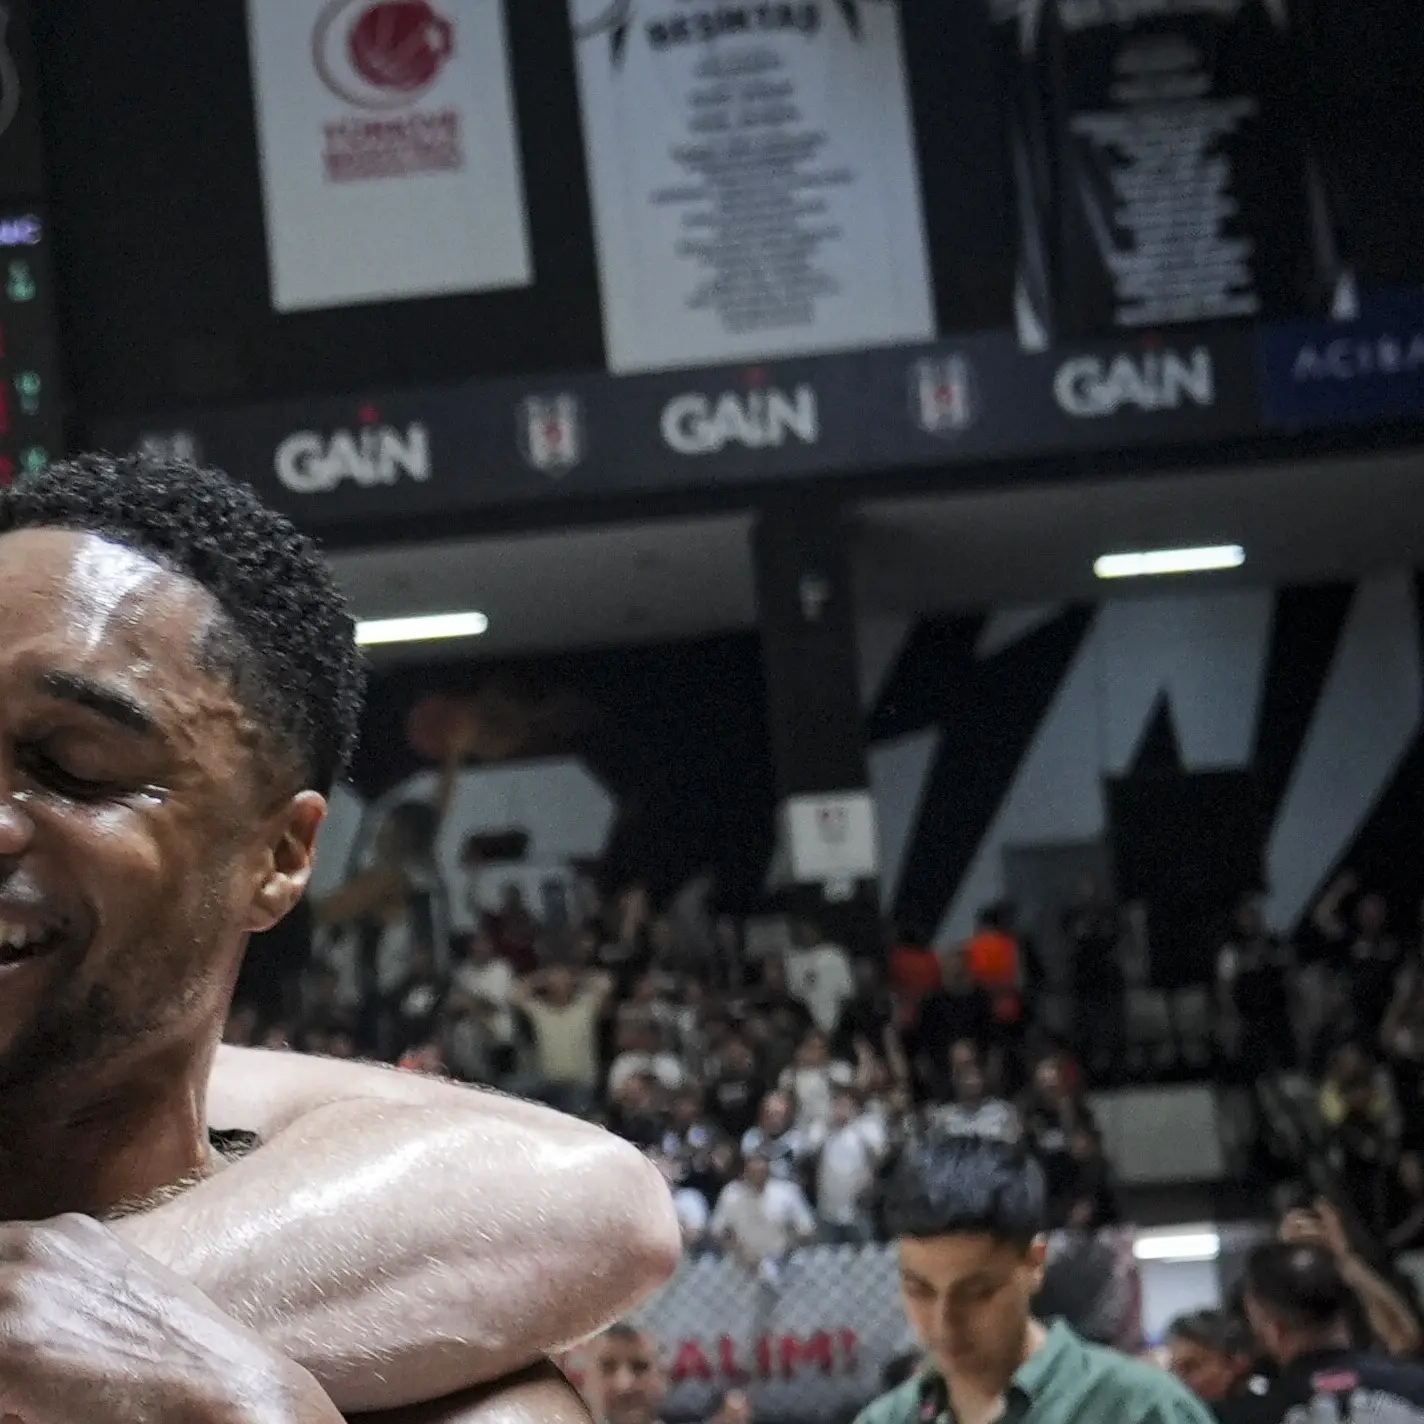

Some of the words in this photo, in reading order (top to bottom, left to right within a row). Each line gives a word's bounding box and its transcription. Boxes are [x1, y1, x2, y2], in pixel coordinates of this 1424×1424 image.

[1054, 348, 1214, 417] GAIN
[660, 384, 817, 454] GAIN
[274, 423, 430, 492] GAIN
